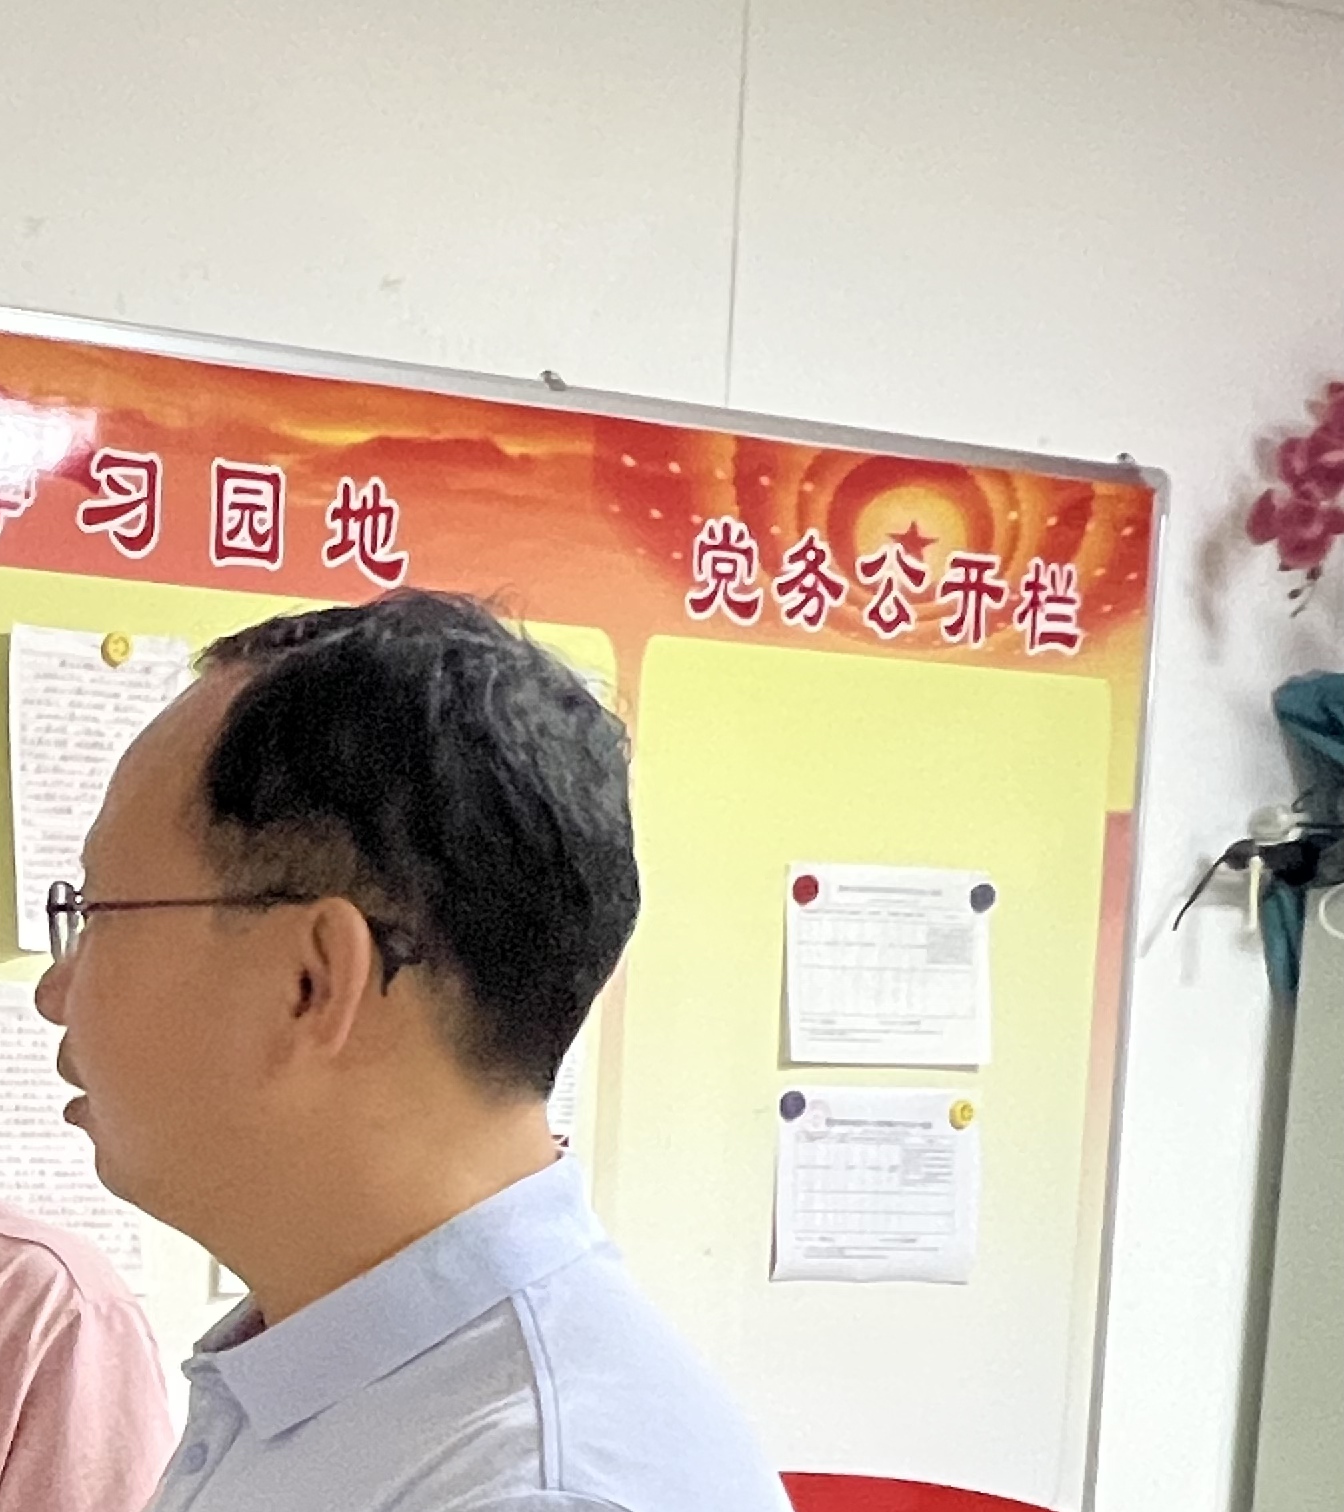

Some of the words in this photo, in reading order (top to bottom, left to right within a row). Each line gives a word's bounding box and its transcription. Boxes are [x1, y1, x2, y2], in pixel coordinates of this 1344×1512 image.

[686, 516, 1084, 655] 党务公开栏
